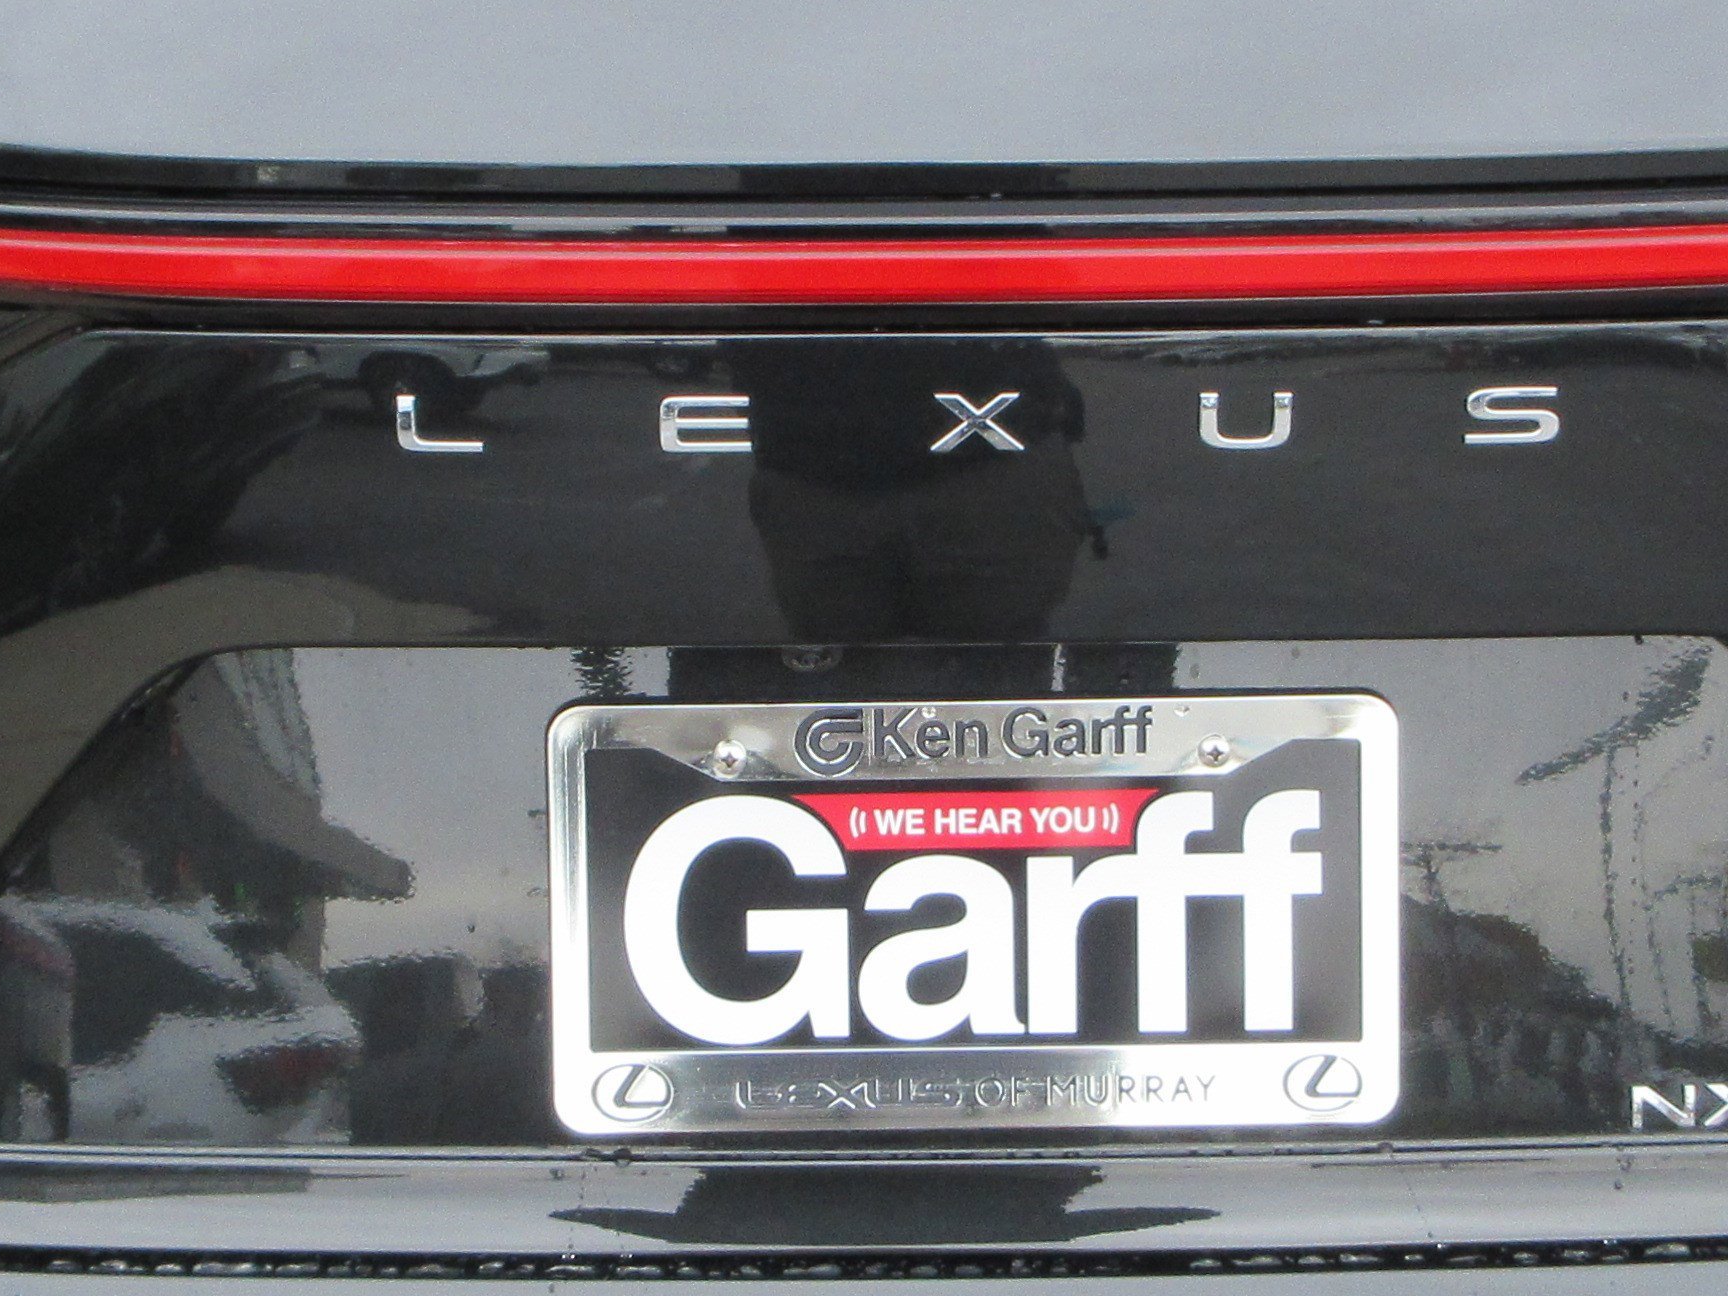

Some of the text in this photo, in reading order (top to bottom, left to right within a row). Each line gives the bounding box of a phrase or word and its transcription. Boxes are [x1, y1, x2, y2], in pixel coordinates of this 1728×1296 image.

[394, 386, 1562, 454] LEXUS
[873, 706, 1153, 760] Ken Garff
[875, 804, 1099, 836] WE HEAR YOU
[624, 789, 1324, 1046] Garff
[976, 1079, 1029, 1106] OF
[1046, 1074, 1218, 1106] MURRAY
